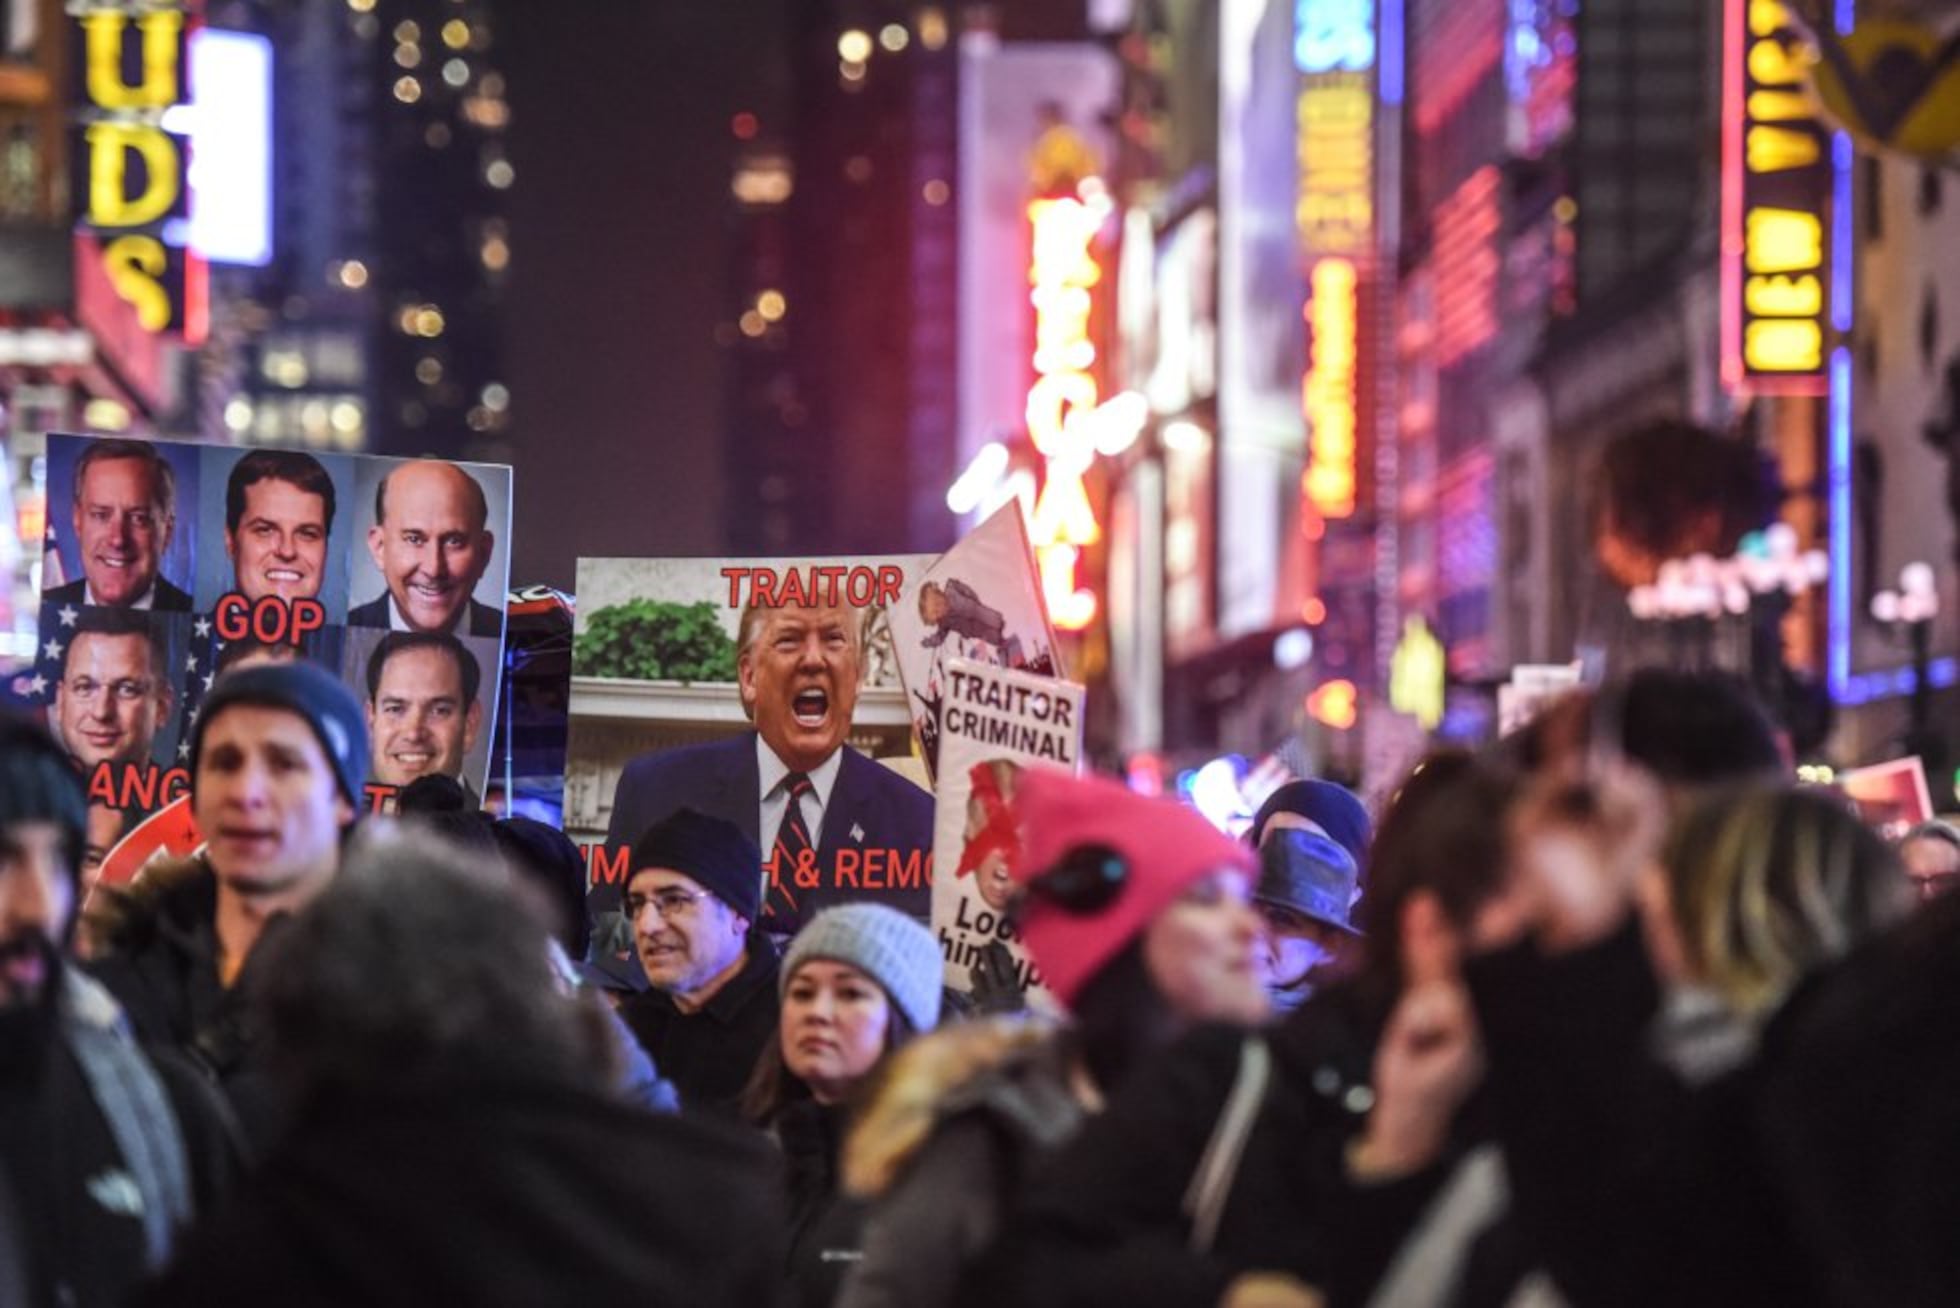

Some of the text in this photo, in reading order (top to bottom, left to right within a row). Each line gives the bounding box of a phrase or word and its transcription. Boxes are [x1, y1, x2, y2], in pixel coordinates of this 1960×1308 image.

[720, 565, 904, 609] TRAITOR
[215, 592, 326, 647] GOP
[949, 669, 1073, 729] TRAITOR
[945, 707, 1071, 764] CRIMINAL
[793, 848, 820, 889] &
[954, 896, 1022, 946] Loo
